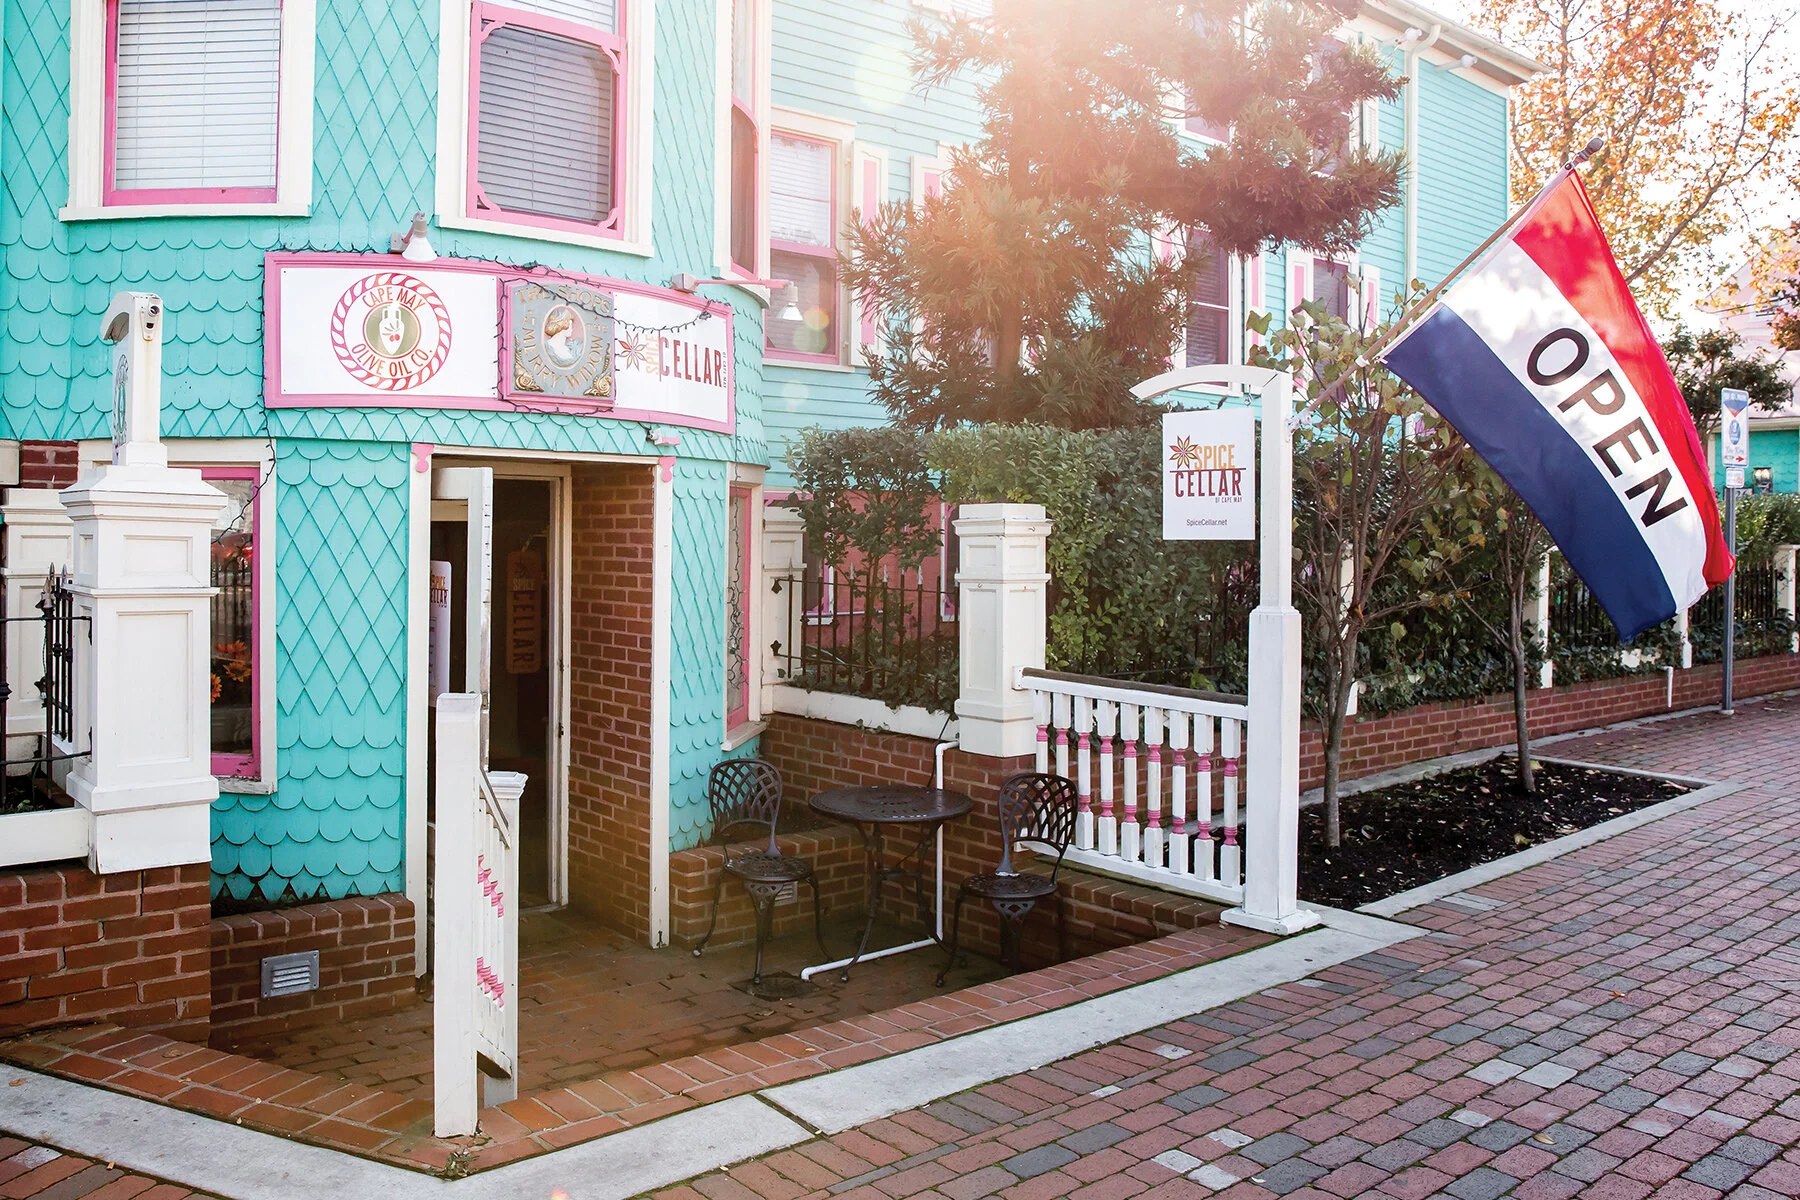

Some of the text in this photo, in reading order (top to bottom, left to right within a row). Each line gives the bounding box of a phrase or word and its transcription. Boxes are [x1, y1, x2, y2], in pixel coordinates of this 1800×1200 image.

[362, 286, 427, 311] CAPE MAY
[516, 285, 611, 314] THE SHOPS
[522, 316, 608, 333] AT THE
[351, 343, 433, 377] OLIVE OIL CO.
[522, 327, 604, 390] MERRY WIDOW
[645, 334, 660, 376] SPICE
[659, 336, 722, 388] CELLAR
[1526, 327, 1689, 528] OPEN
[1194, 444, 1236, 470] SPICE
[1175, 469, 1242, 497] CELLAR
[1186, 518, 1228, 527] SpiceCellar.net
[512, 577, 536, 591] SPICE
[512, 590, 535, 663] CELLAR
